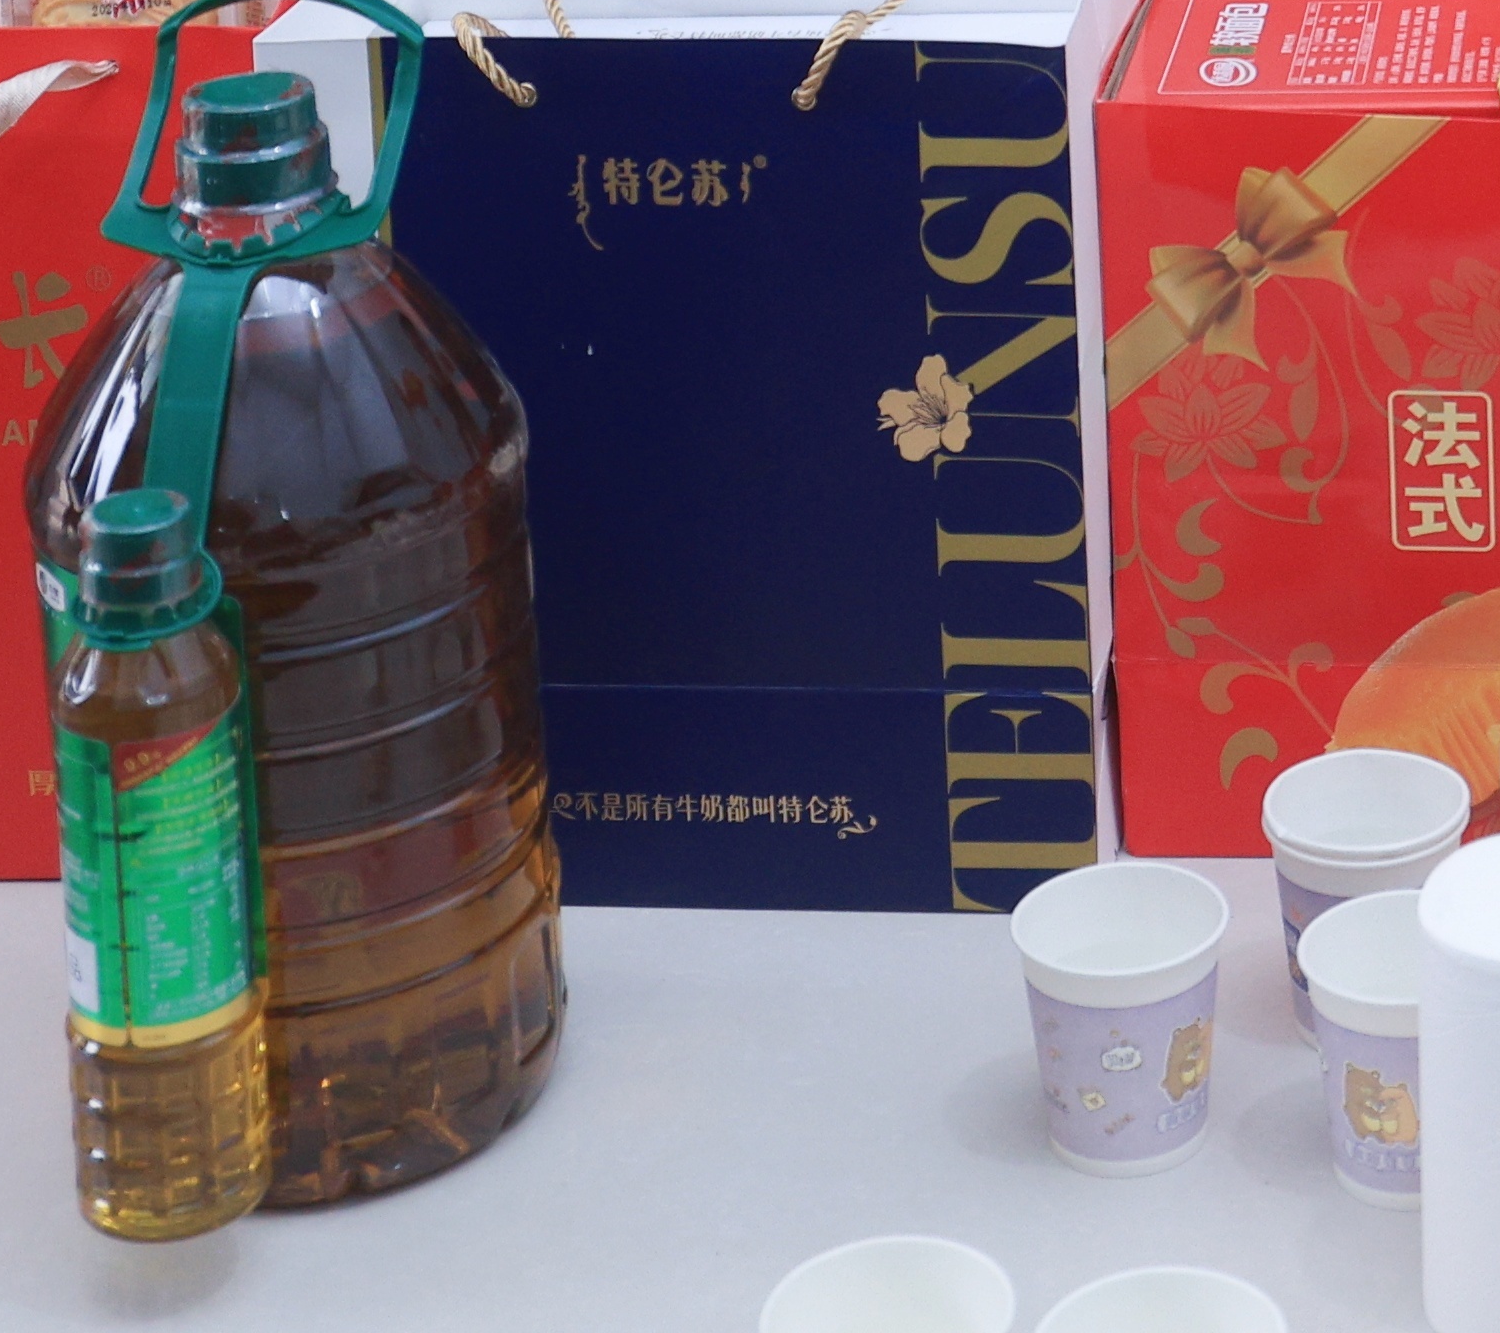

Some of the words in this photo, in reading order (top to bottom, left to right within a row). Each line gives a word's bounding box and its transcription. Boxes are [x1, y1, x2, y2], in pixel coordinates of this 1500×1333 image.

[601, 157, 730, 207] 特仑苏
[1401, 400, 1485, 543] 法式
[576, 793, 854, 824] 不是所有牛奶都叫特仑苏
